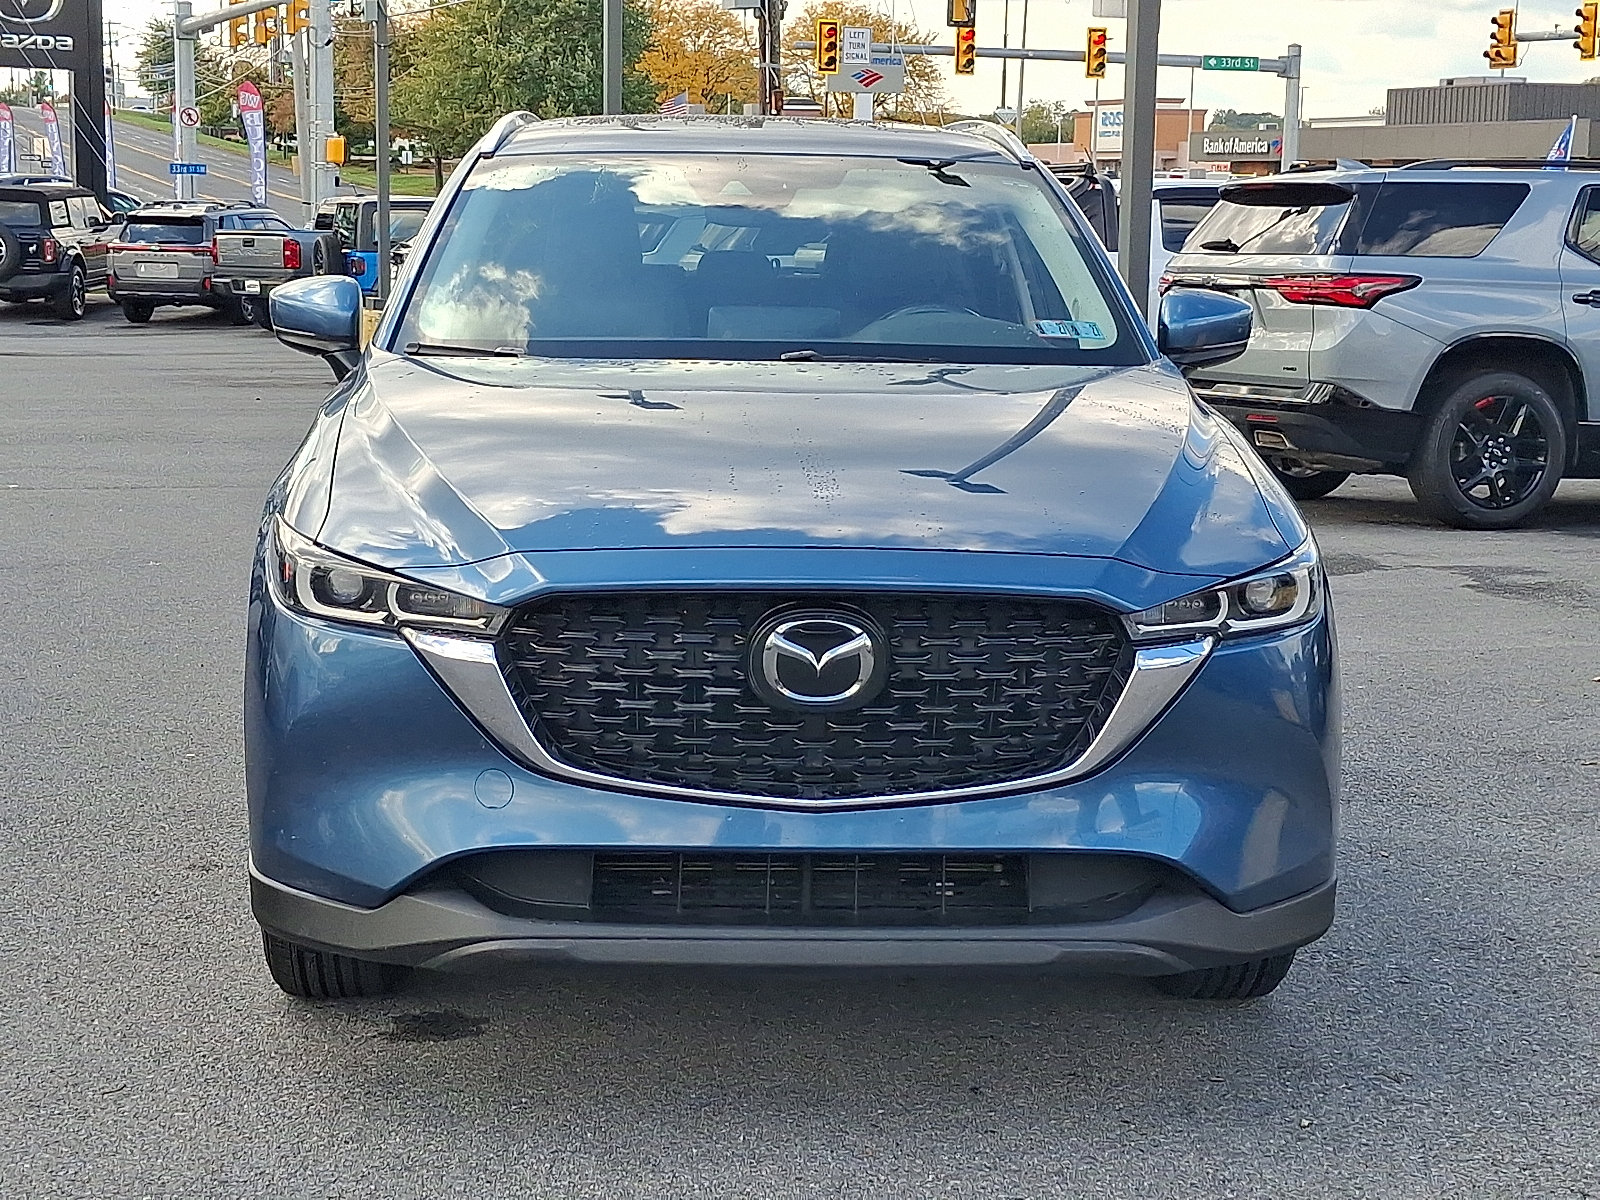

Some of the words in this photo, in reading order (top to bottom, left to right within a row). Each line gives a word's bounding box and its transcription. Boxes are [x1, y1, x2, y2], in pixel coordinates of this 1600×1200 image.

[849, 31, 865, 39] LEFT
[0, 34, 74, 51] azda
[848, 41, 866, 50] TURN
[871, 55, 902, 66] merica
[1220, 58, 1240, 67] 33rd
[1244, 58, 1254, 68] St
[1203, 137, 1224, 154] Bank
[1224, 137, 1233, 154] of
[1232, 136, 1268, 154] America
[171, 164, 187, 173] 33rd
